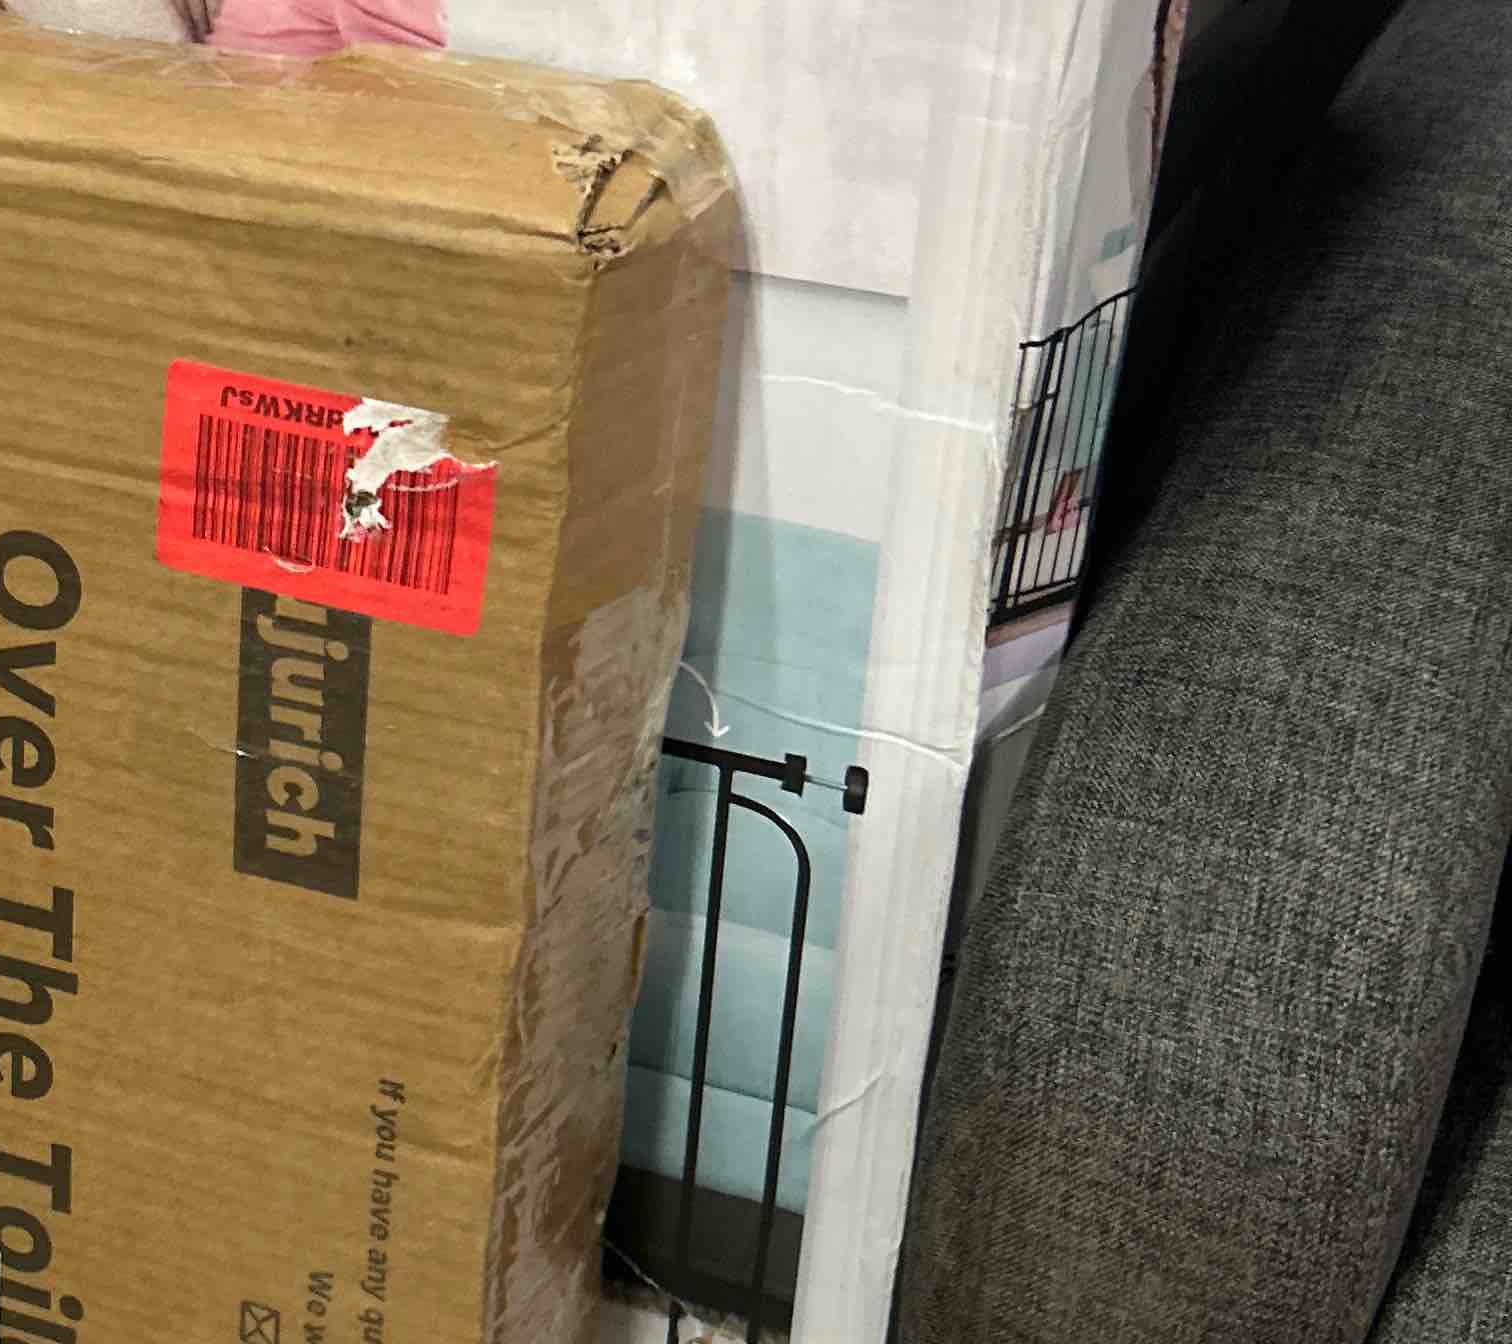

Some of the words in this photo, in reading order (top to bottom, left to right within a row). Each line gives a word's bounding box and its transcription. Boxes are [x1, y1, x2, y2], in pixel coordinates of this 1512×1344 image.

[377, 1078, 406, 1103] If
[370, 1104, 402, 1162] you
[367, 1168, 400, 1241] have
[306, 1271, 335, 1318] We
[361, 1247, 391, 1301] any
